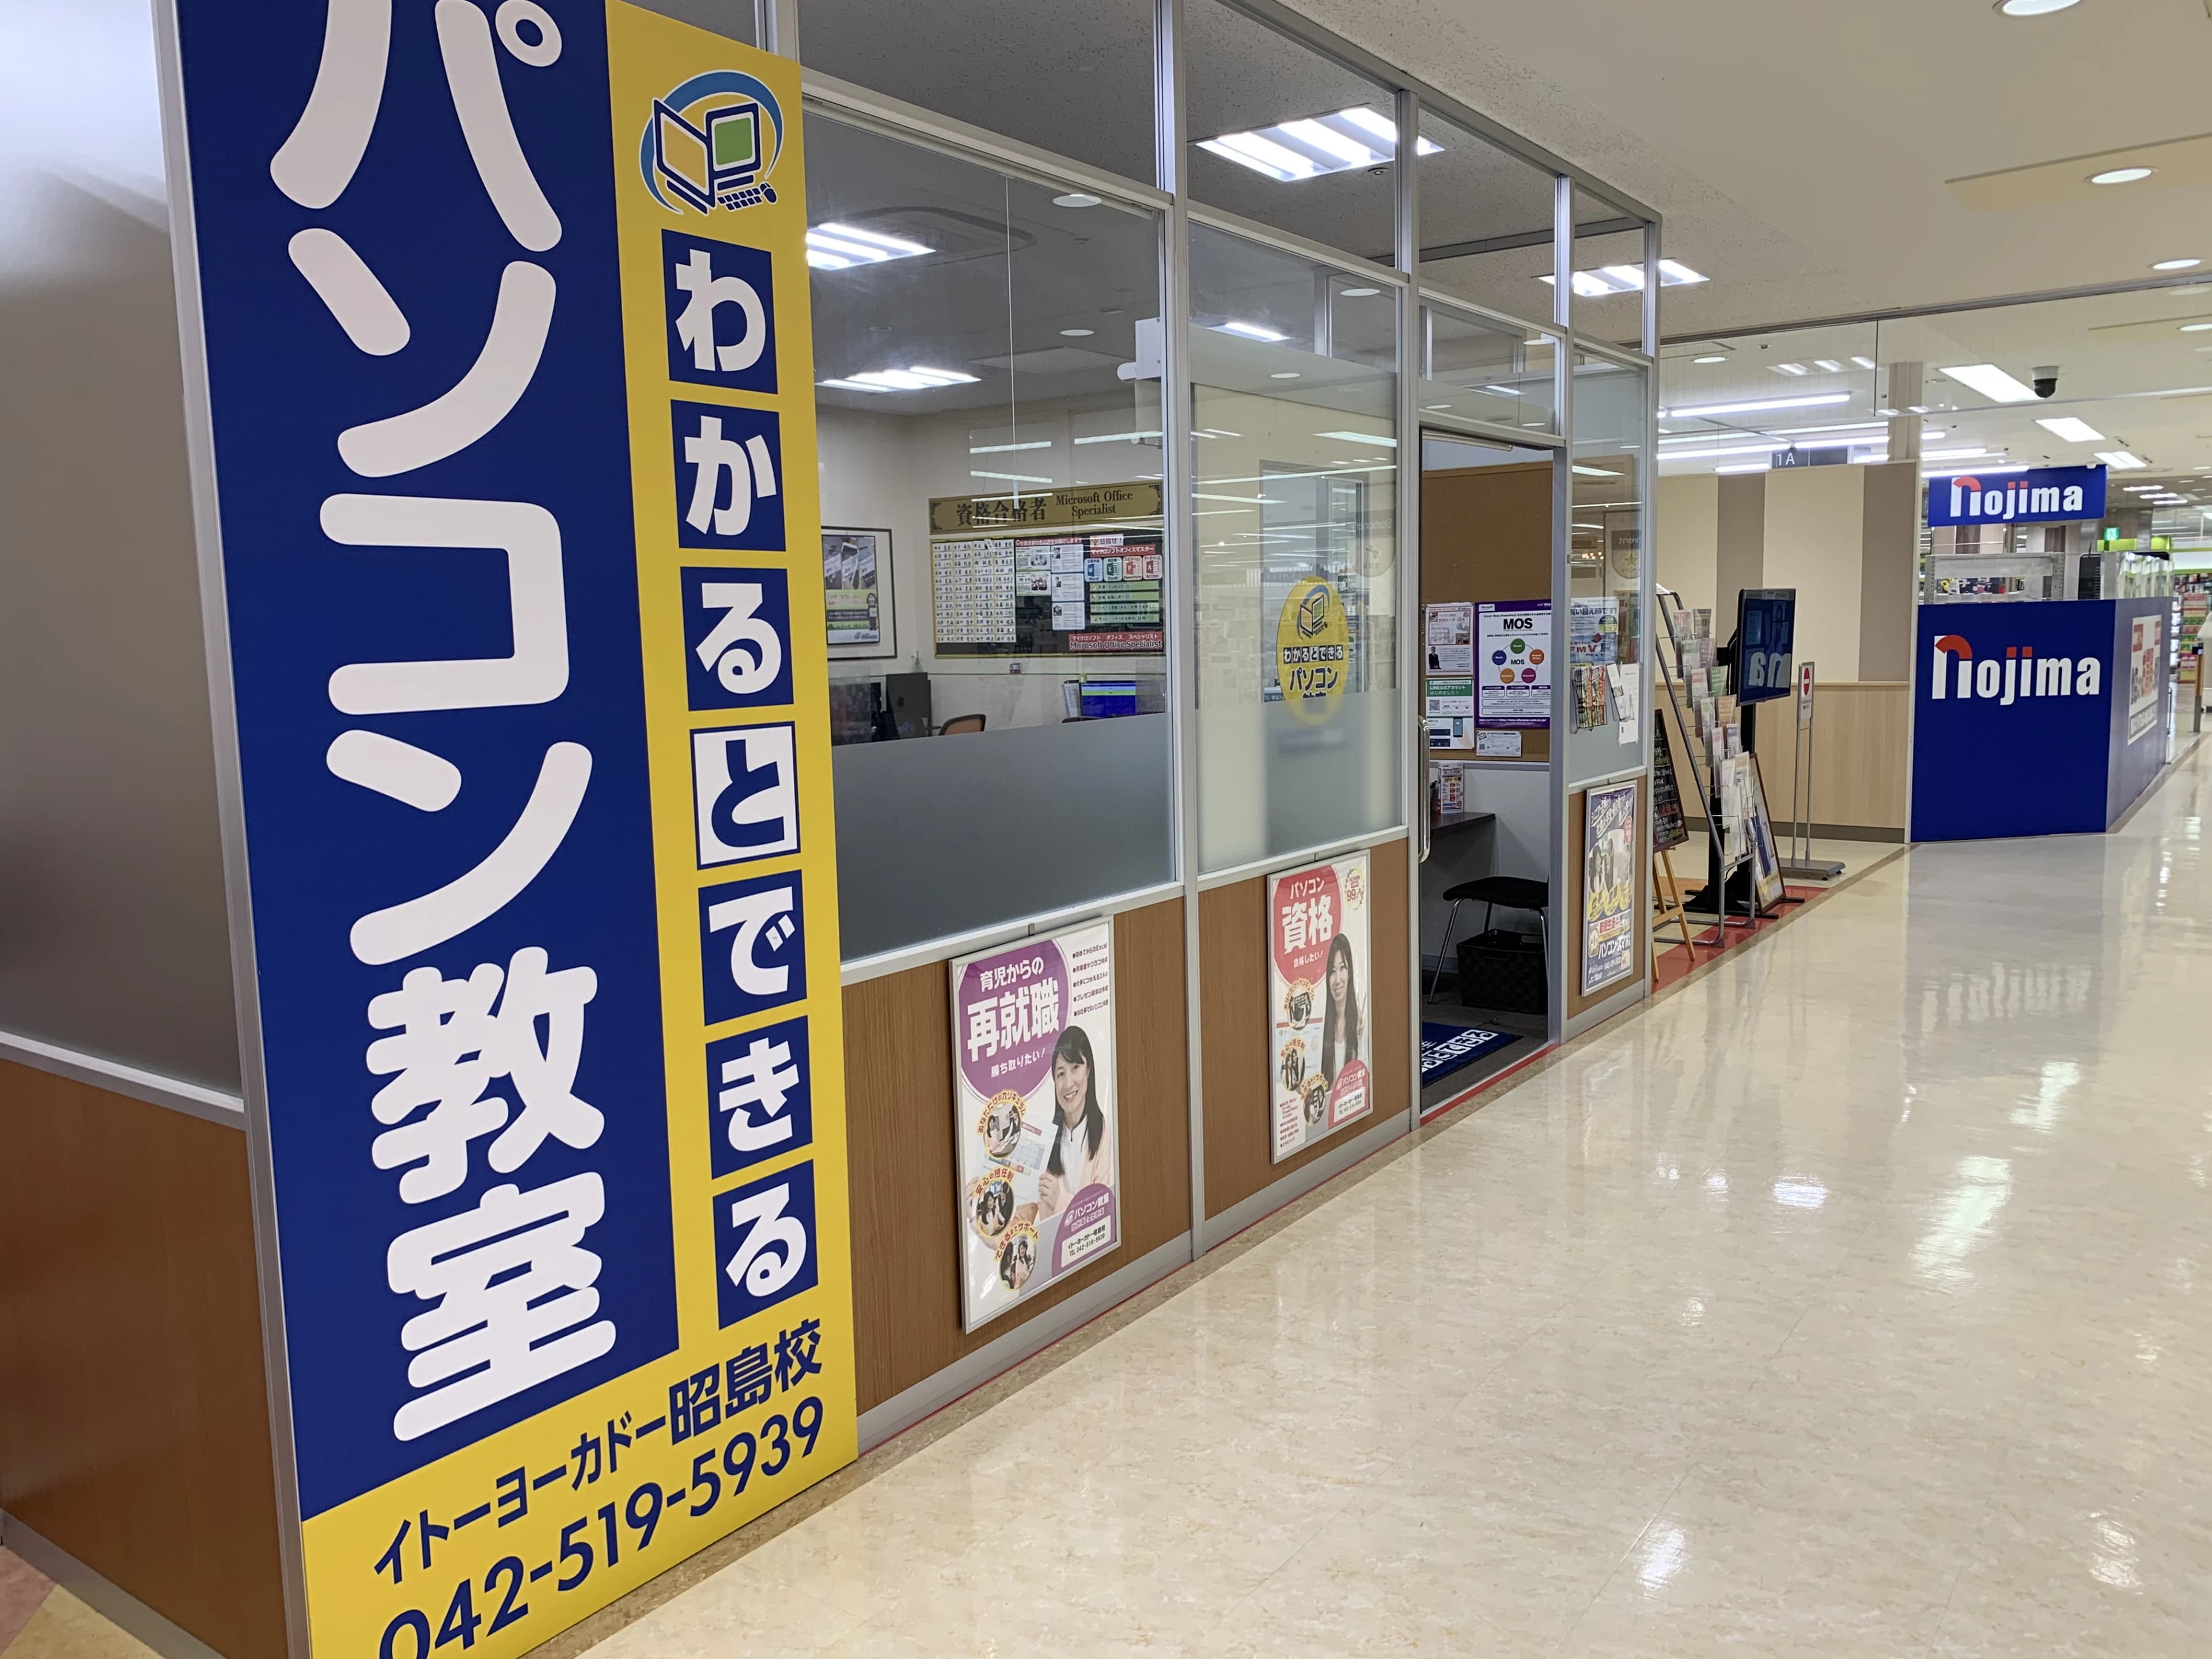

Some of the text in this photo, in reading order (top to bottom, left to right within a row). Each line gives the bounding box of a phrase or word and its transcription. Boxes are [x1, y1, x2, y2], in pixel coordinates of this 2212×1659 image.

[956, 498, 1047, 526] 資格合格者
[1056, 491, 1133, 506] Microsoft Office
[1071, 503, 1116, 518] Specialist
[1950, 476, 2083, 520] nojima
[1503, 618, 1533, 630] MOS
[1070, 641, 1103, 649] Microsoft
[1126, 640, 1162, 649] Specialist
[1283, 645, 1343, 663] わかるとできる
[1289, 666, 1338, 691] パソコン
[1932, 634, 2101, 705] nojima
[270, 0, 616, 1441] パソコン教室
[675, 249, 806, 1296] わかるとできる
[1290, 877, 1325, 900] パソコン
[1282, 895, 1333, 955] 資格
[979, 956, 1044, 993] 育児からの
[1294, 950, 1323, 968] 合格したい！
[967, 976, 1059, 1062] 再就職
[990, 1048, 1046, 1080] 勝ち取りたい！
[979, 1092, 1026, 1133] あなただけのカリキュラム
[976, 1168, 1014, 1196] 安心の担任制
[995, 1222, 1039, 1259] できるまでサポート
[373, 1318, 823, 1584] イトーヨーカドー昭島校
[379, 1396, 823, 1659] 042-519-5939
